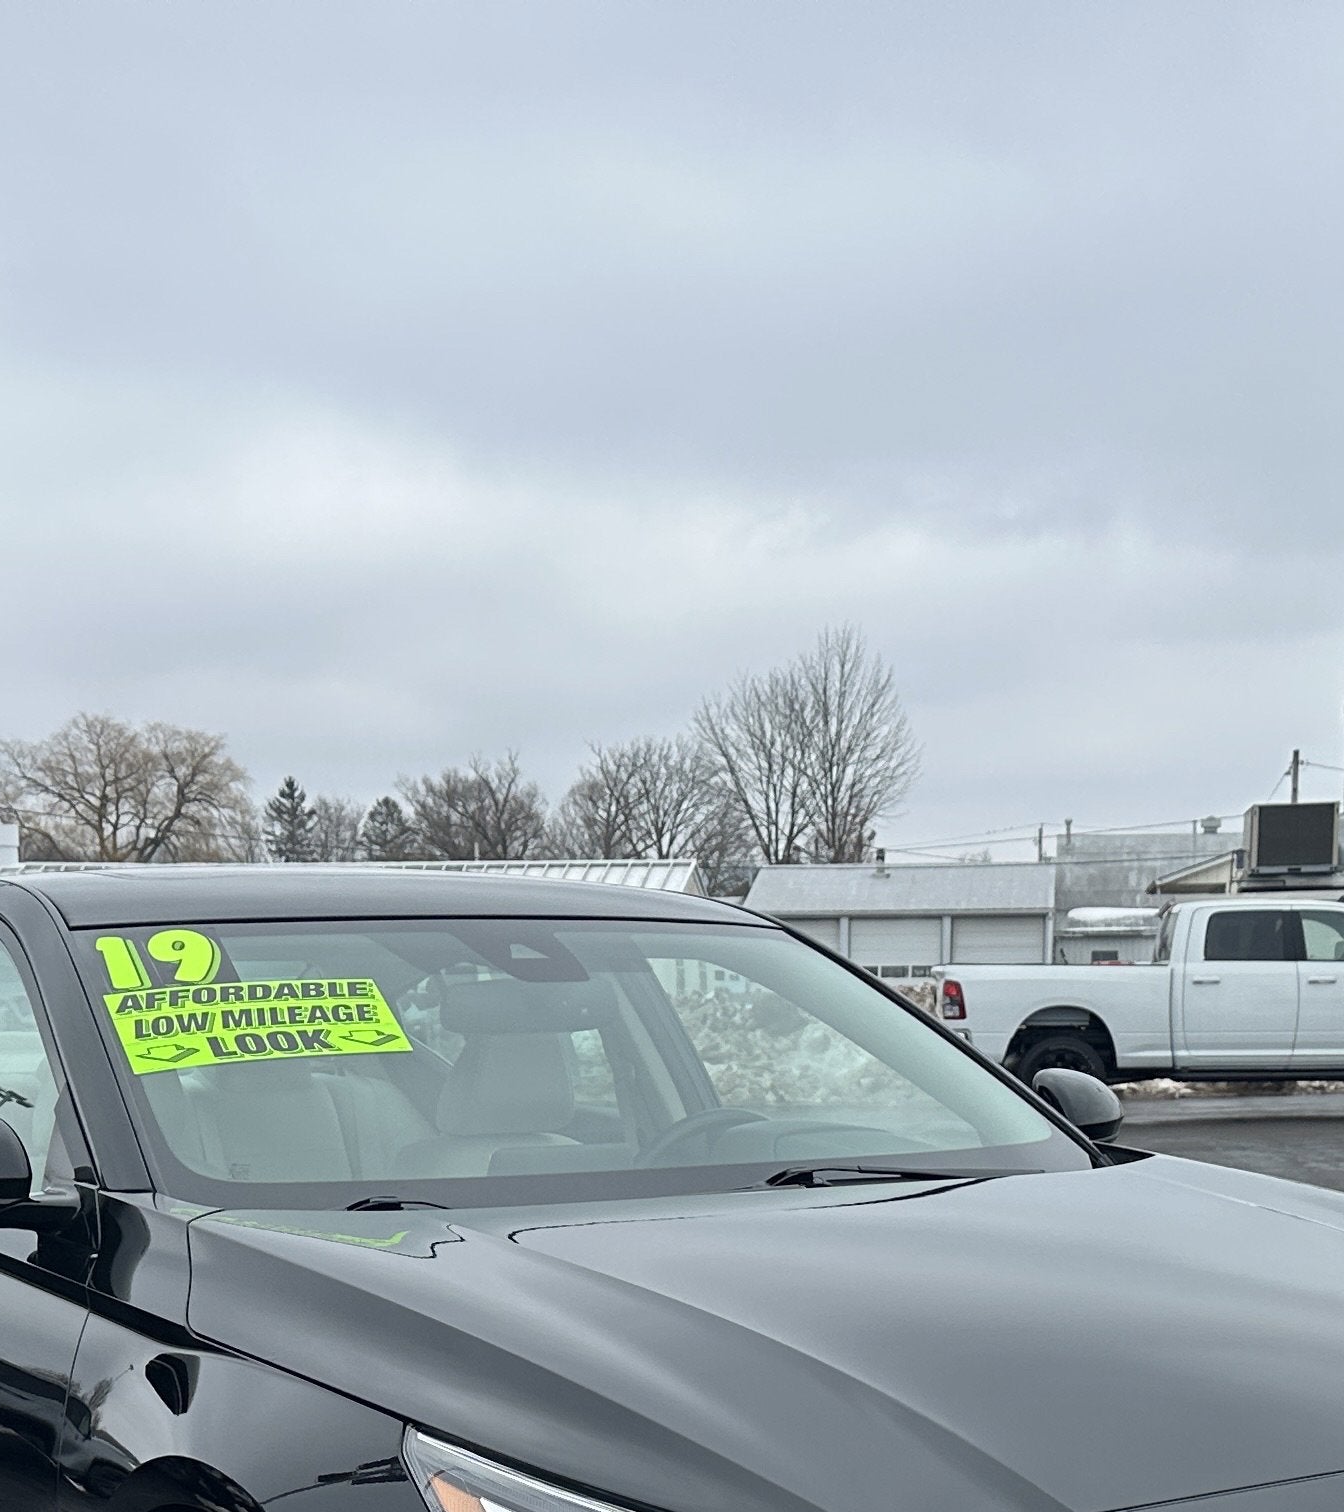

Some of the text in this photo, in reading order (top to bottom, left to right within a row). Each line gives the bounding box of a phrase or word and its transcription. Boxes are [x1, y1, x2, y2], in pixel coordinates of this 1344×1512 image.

[95, 929, 221, 990] 19
[115, 981, 374, 1015] AFFORDABLE
[134, 1004, 379, 1040] LOW MILEAGE
[206, 1029, 340, 1060] LOOK
